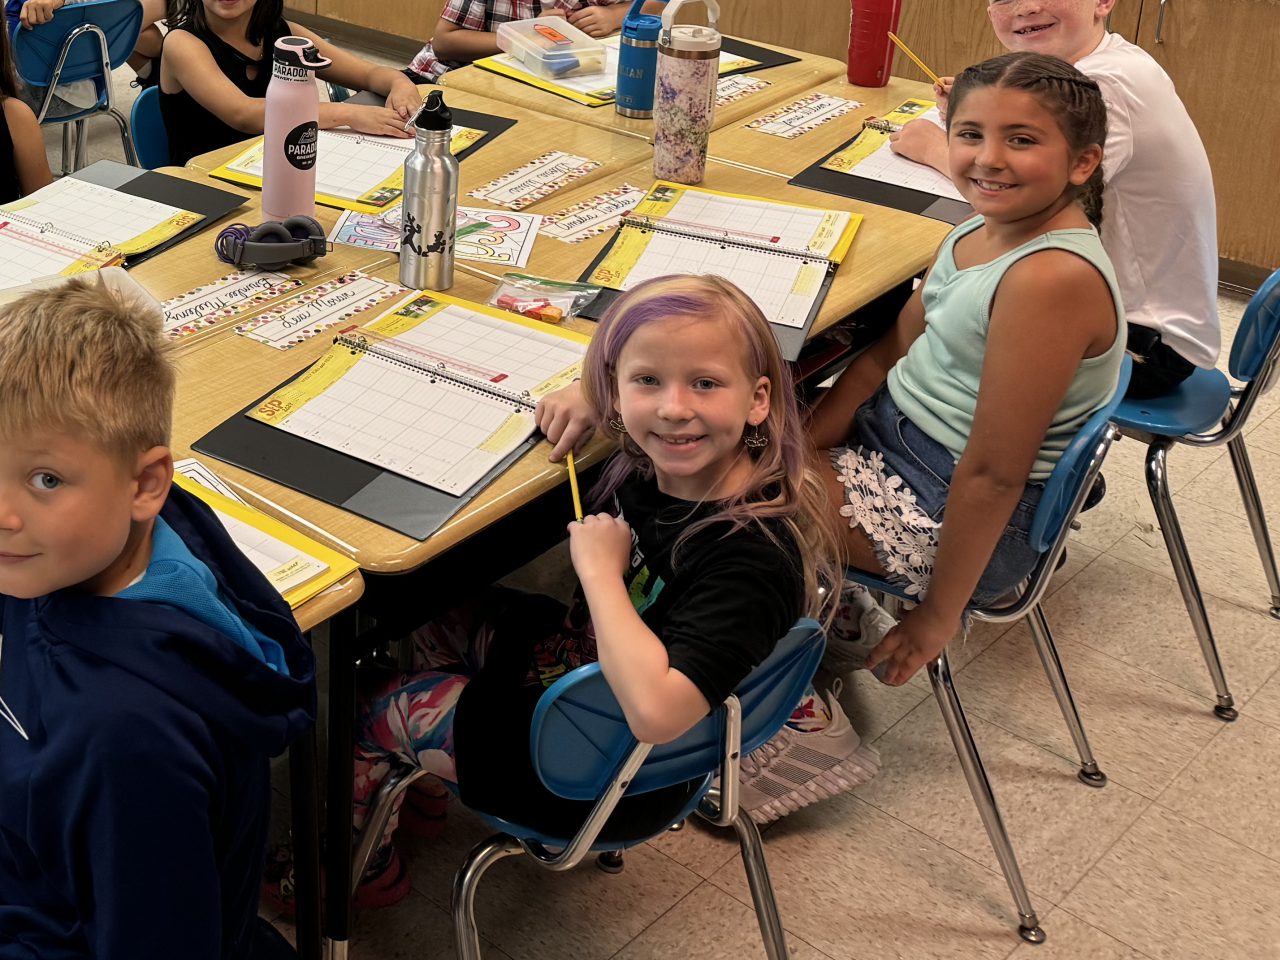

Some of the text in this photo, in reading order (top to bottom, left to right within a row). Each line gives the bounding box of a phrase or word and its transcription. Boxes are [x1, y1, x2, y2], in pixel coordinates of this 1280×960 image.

[273, 63, 308, 78] PARADOX
[288, 142, 317, 155] PARADO
[225, 276, 276, 299] Brinlee
[258, 398, 283, 417] SEP
